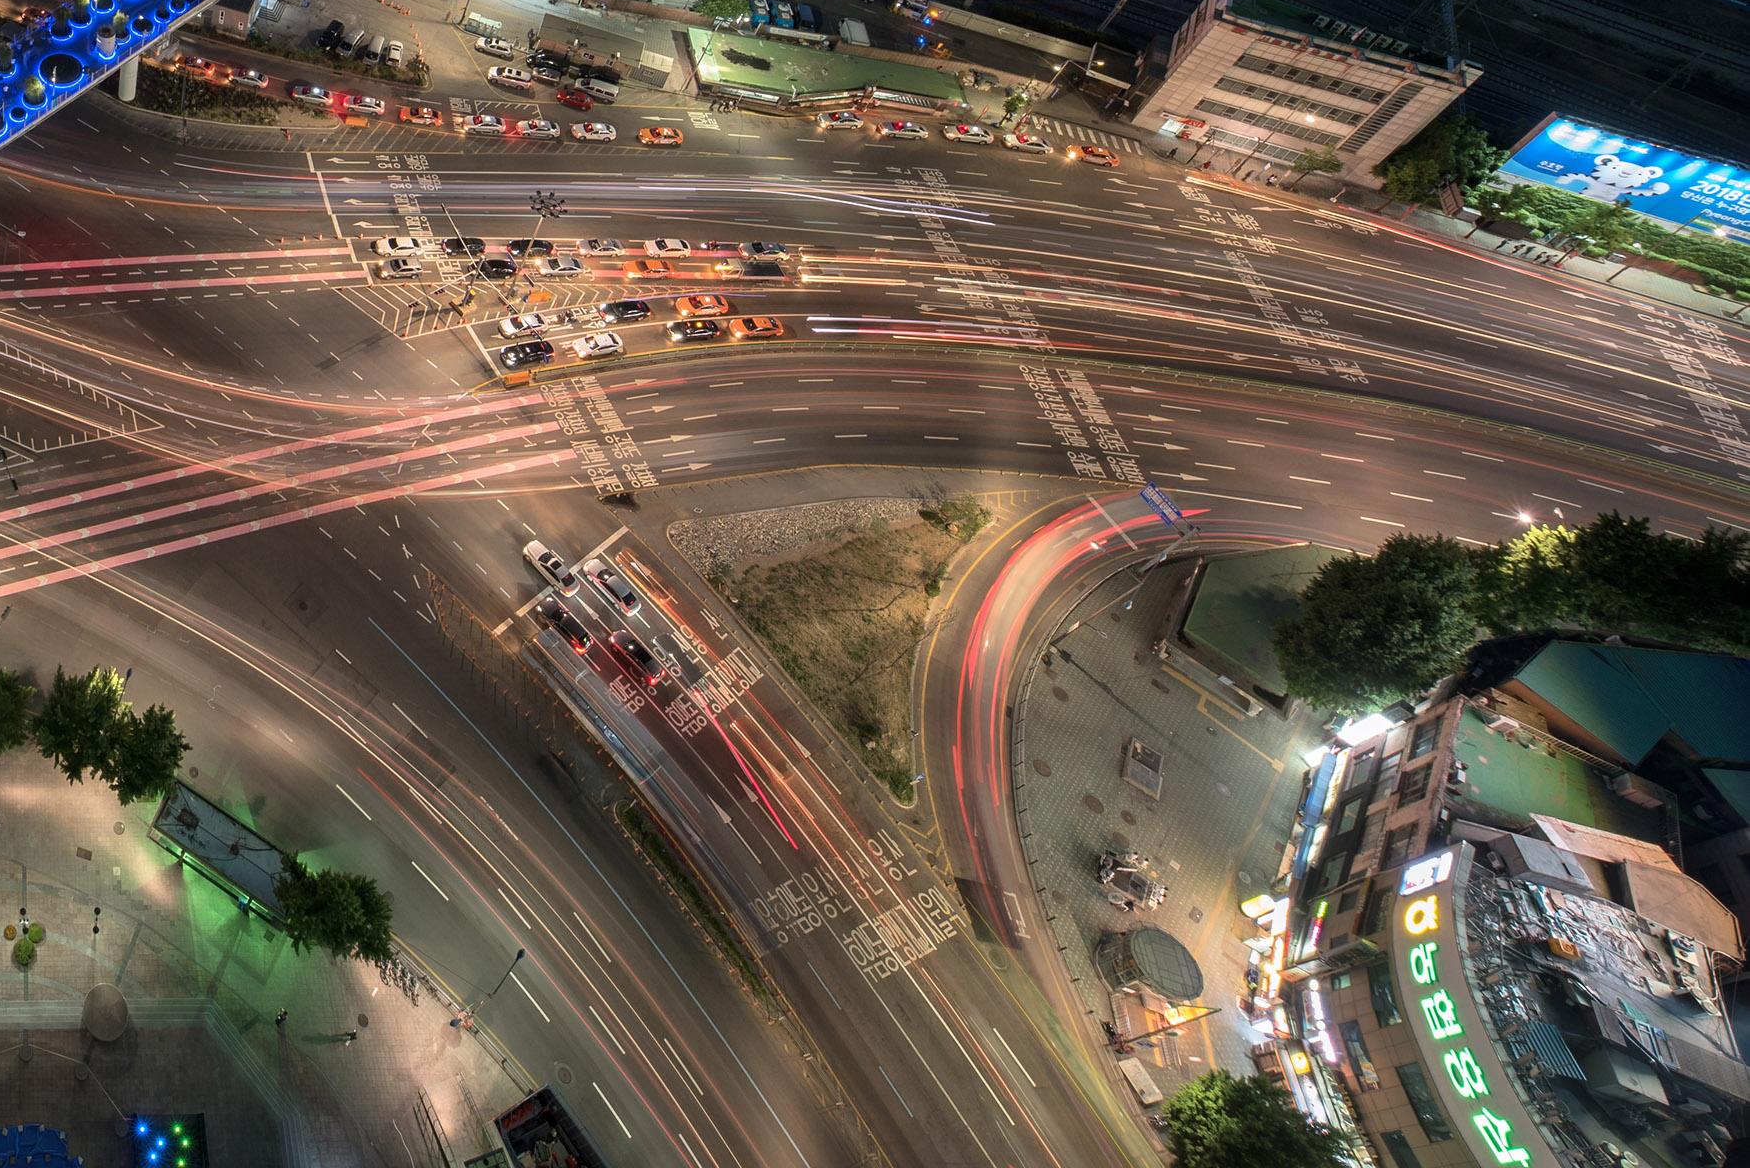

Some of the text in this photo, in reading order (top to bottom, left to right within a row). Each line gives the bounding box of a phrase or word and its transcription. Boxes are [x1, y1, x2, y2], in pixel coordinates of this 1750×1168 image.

[554, 408, 591, 436] 경찰청
[604, 432, 642, 459] 공덕동
[587, 466, 625, 494] 숭례문
[621, 460, 660, 488] 경찰청
[665, 692, 709, 738] 후암동
[866, 828, 917, 884] 용산
[840, 921, 901, 984] 후암동
